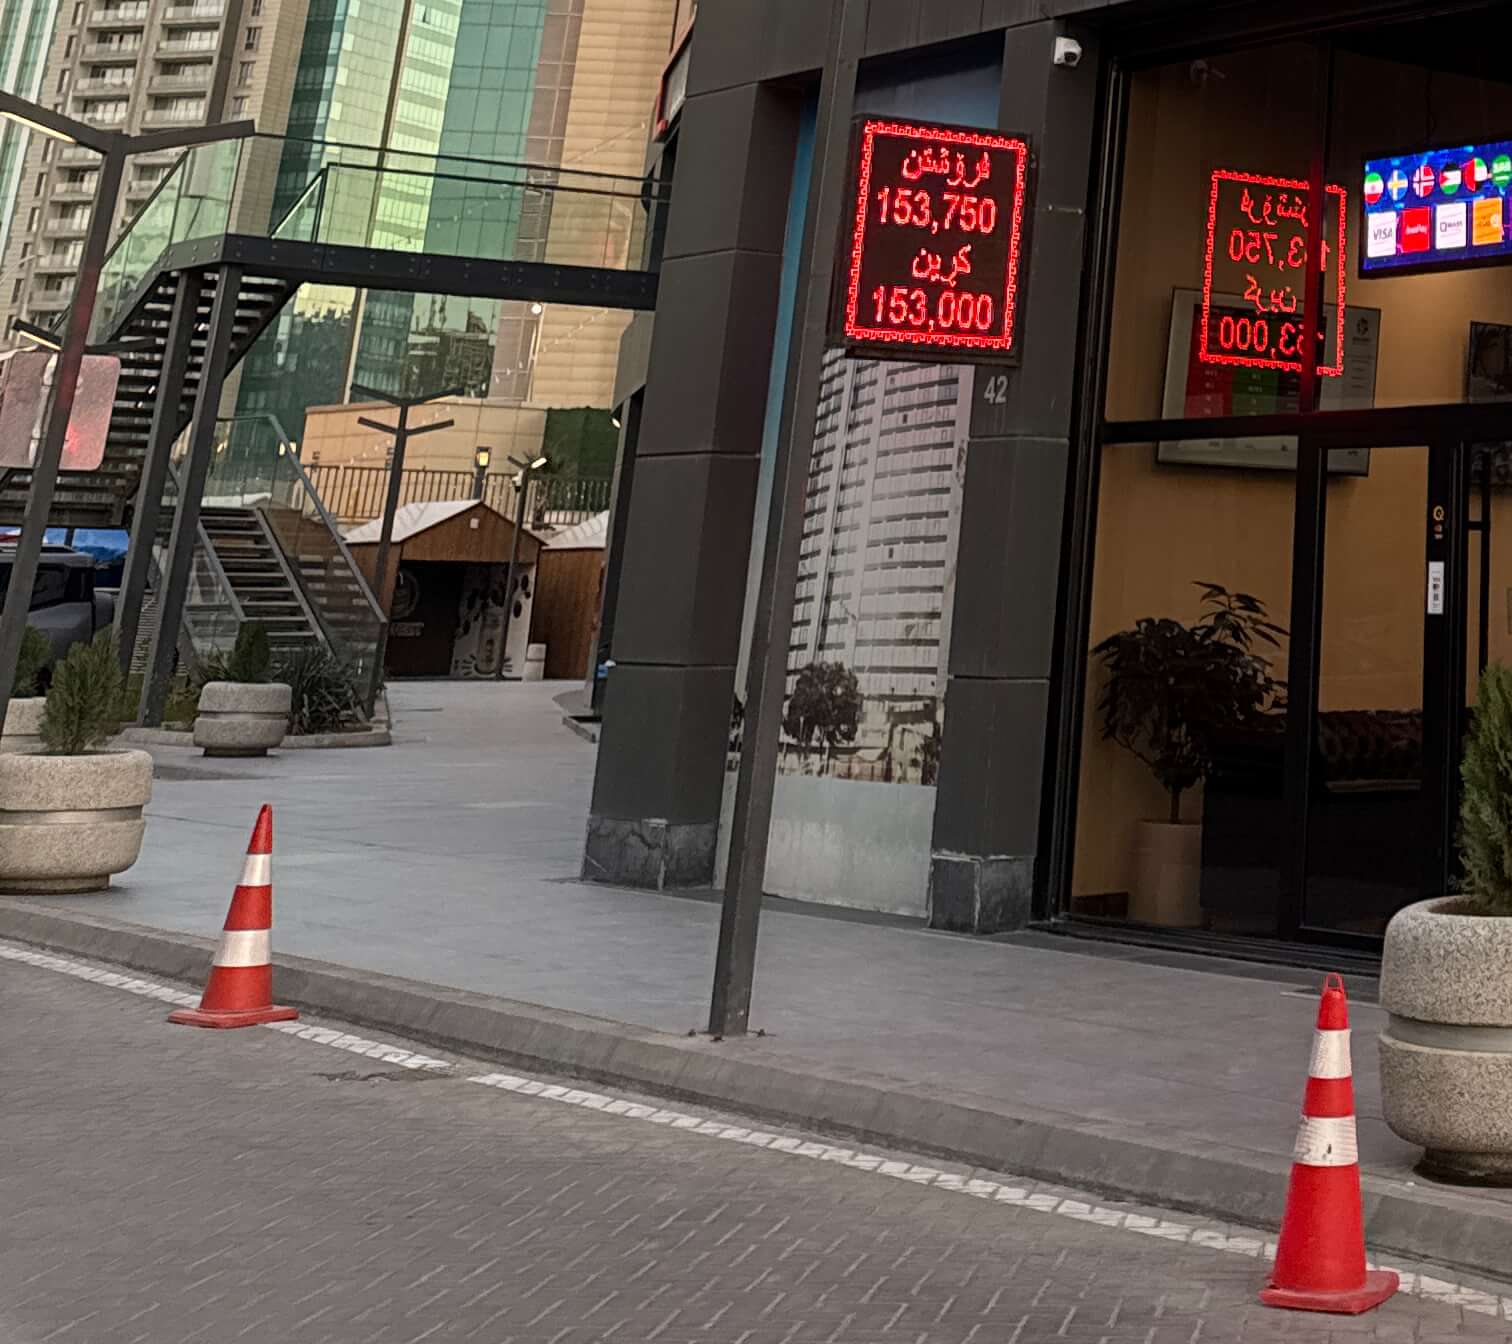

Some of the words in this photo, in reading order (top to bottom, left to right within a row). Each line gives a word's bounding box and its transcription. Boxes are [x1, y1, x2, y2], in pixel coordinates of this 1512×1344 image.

[903, 147, 992, 188] فرۆشتن
[878, 185, 997, 235] 153,750
[1373, 227, 1393, 241] VISA
[872, 284, 993, 333] 153,000
[983, 375, 1009, 404] 42
